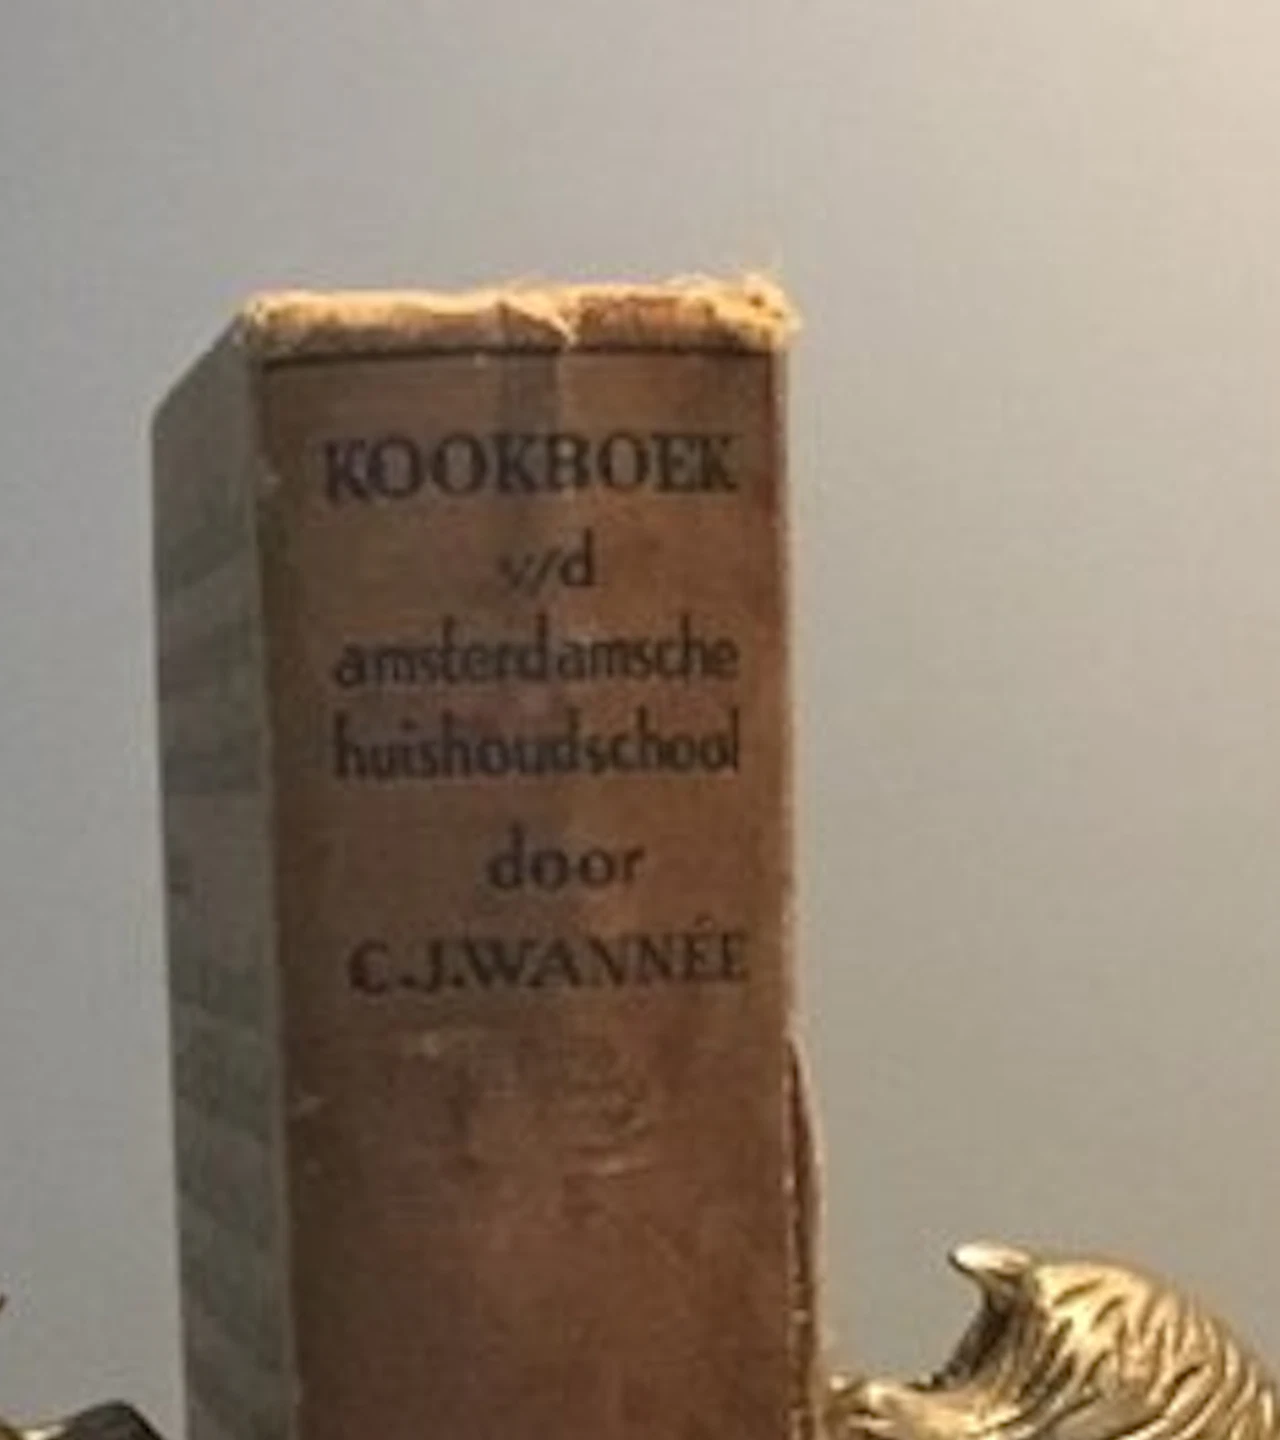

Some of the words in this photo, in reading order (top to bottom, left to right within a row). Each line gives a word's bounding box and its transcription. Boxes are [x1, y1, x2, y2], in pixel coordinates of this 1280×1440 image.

[324, 432, 741, 502] KOOKBOEK
[499, 529, 597, 594] v/d
[333, 614, 741, 690] amsterdamsche
[333, 706, 741, 781] huishoudschool
[487, 822, 646, 892] door
